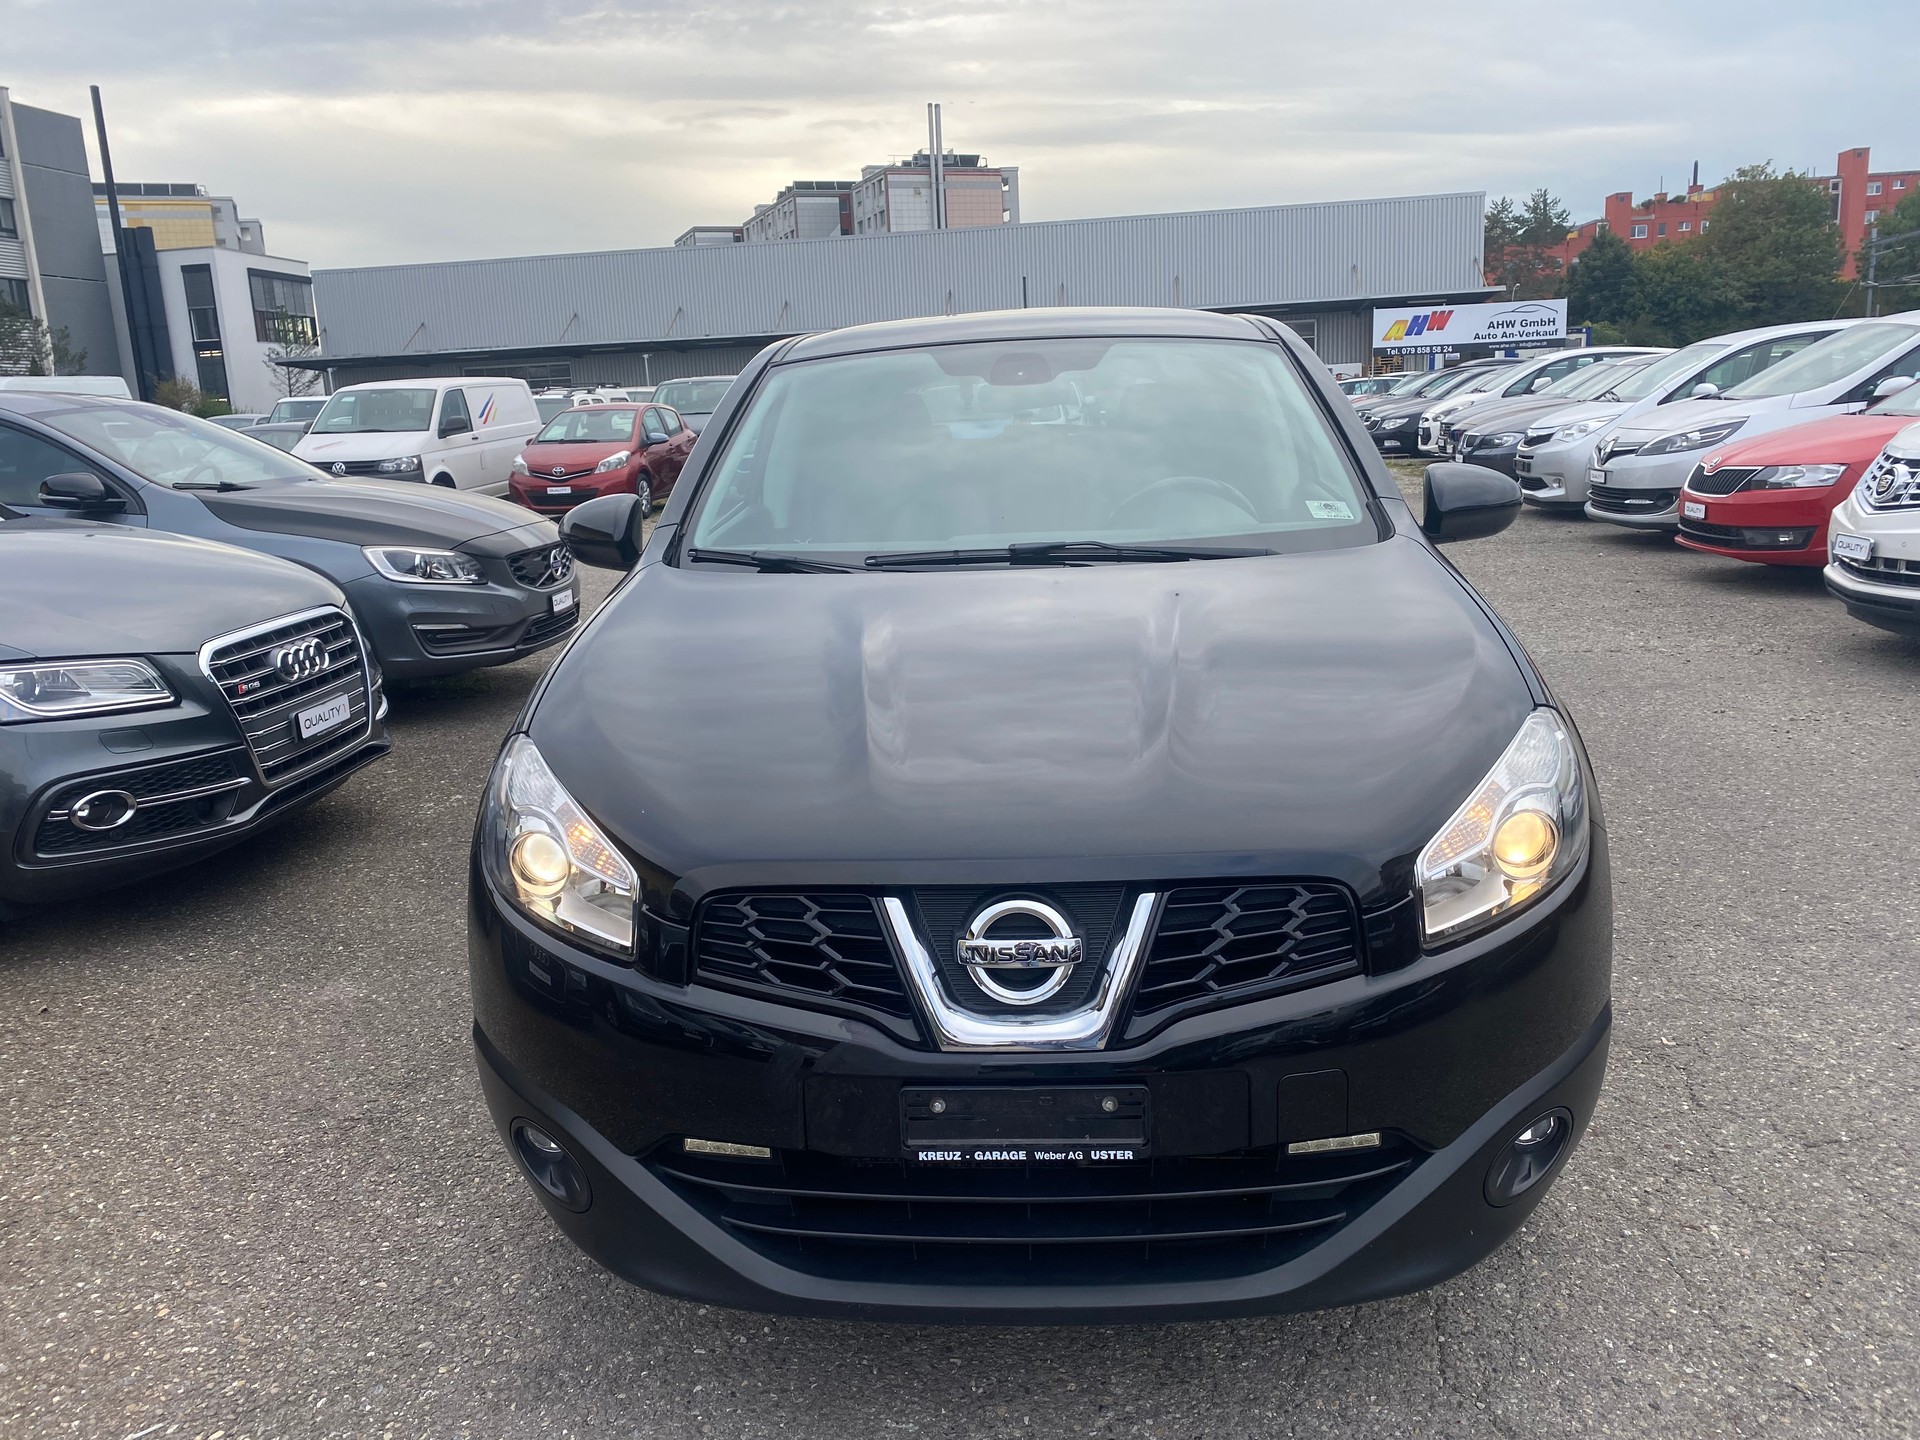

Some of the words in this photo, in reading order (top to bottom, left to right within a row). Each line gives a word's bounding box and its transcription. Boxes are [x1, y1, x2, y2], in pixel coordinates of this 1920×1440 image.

[1382, 310, 1454, 341] AHW
[1487, 319, 1516, 329] AHW
[1520, 317, 1556, 328] GmbH
[1473, 332, 1498, 341] Auto
[1501, 328, 1559, 339] An-Verkauf
[1417, 346, 1430, 354] 858
[1443, 345, 1453, 353] 24
[969, 945, 1069, 963] NISSAN
[918, 1151, 962, 1161] KREUZ
[974, 1150, 1027, 1160] GARAGE
[1034, 1151, 1066, 1160] Weber
[1068, 1151, 1084, 1160] AG
[1091, 1150, 1134, 1160] USTER
